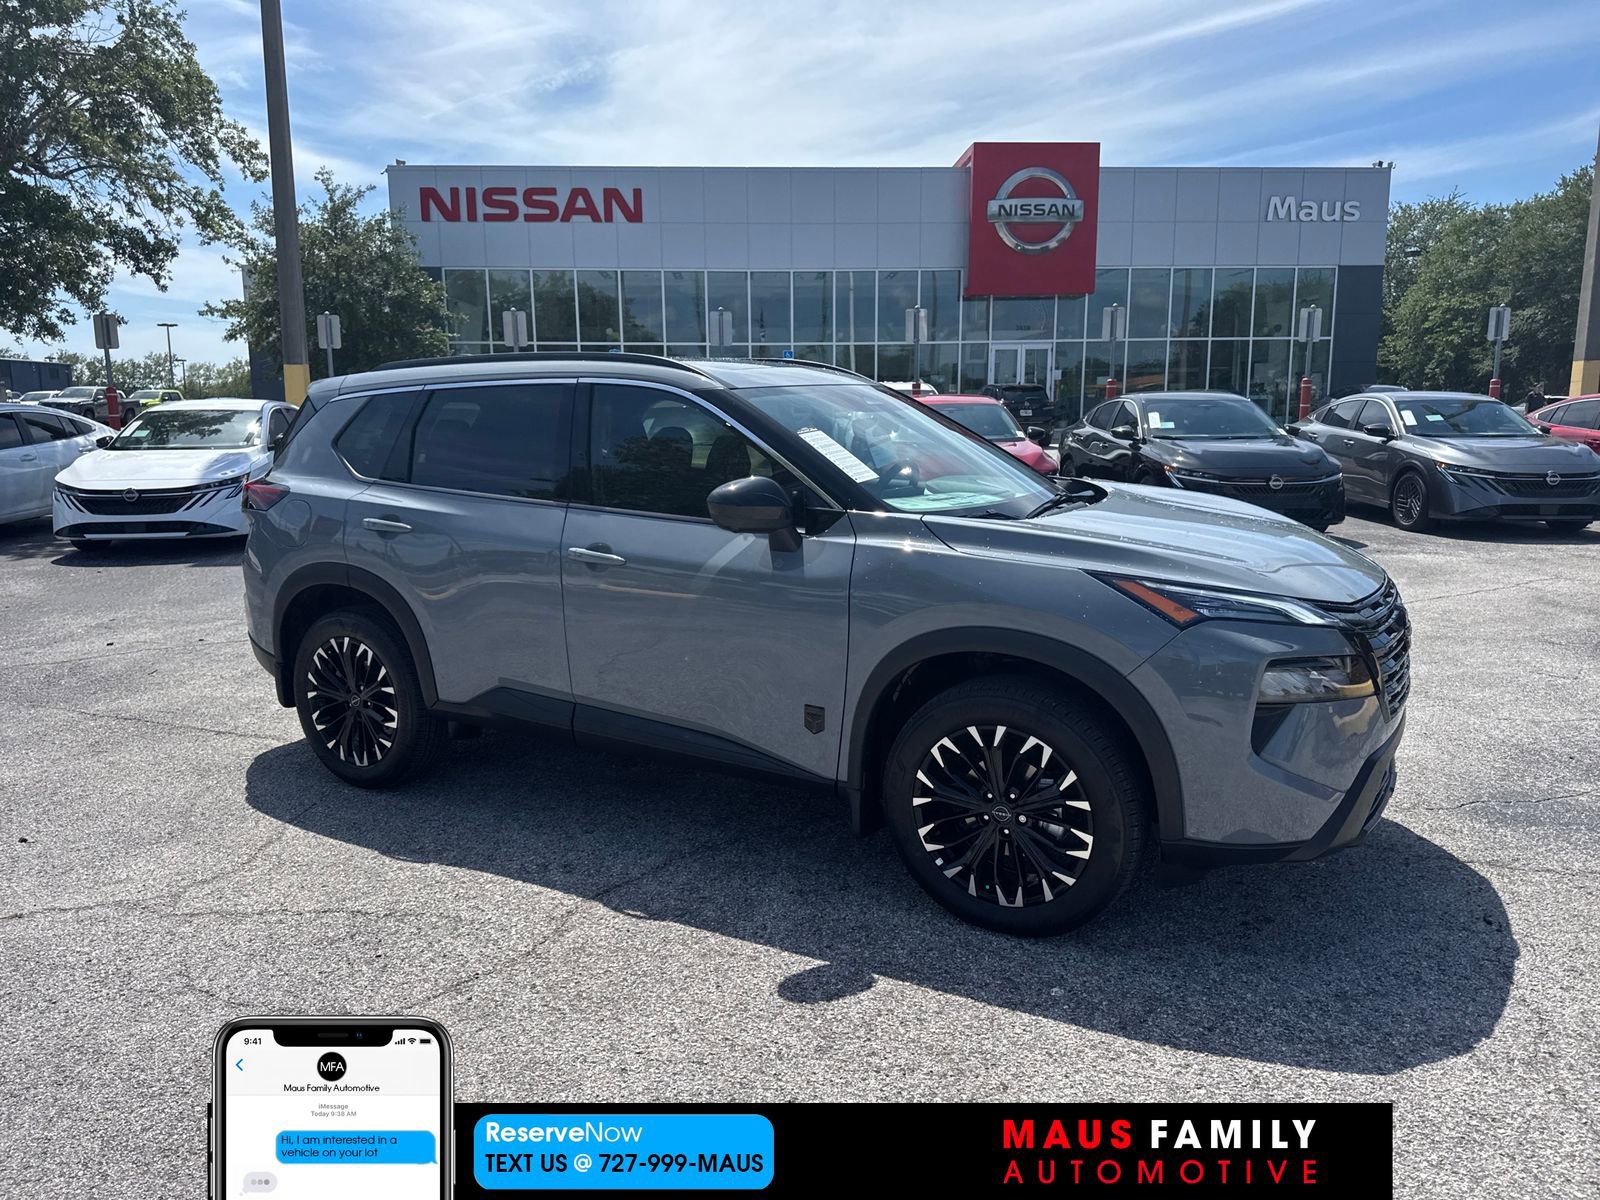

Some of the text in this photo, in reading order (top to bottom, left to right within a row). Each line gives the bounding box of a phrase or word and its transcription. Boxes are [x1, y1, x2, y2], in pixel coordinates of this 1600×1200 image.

[419, 187, 643, 223] NISSAN
[998, 203, 1075, 217] NISSAN
[1266, 196, 1361, 222] Maus
